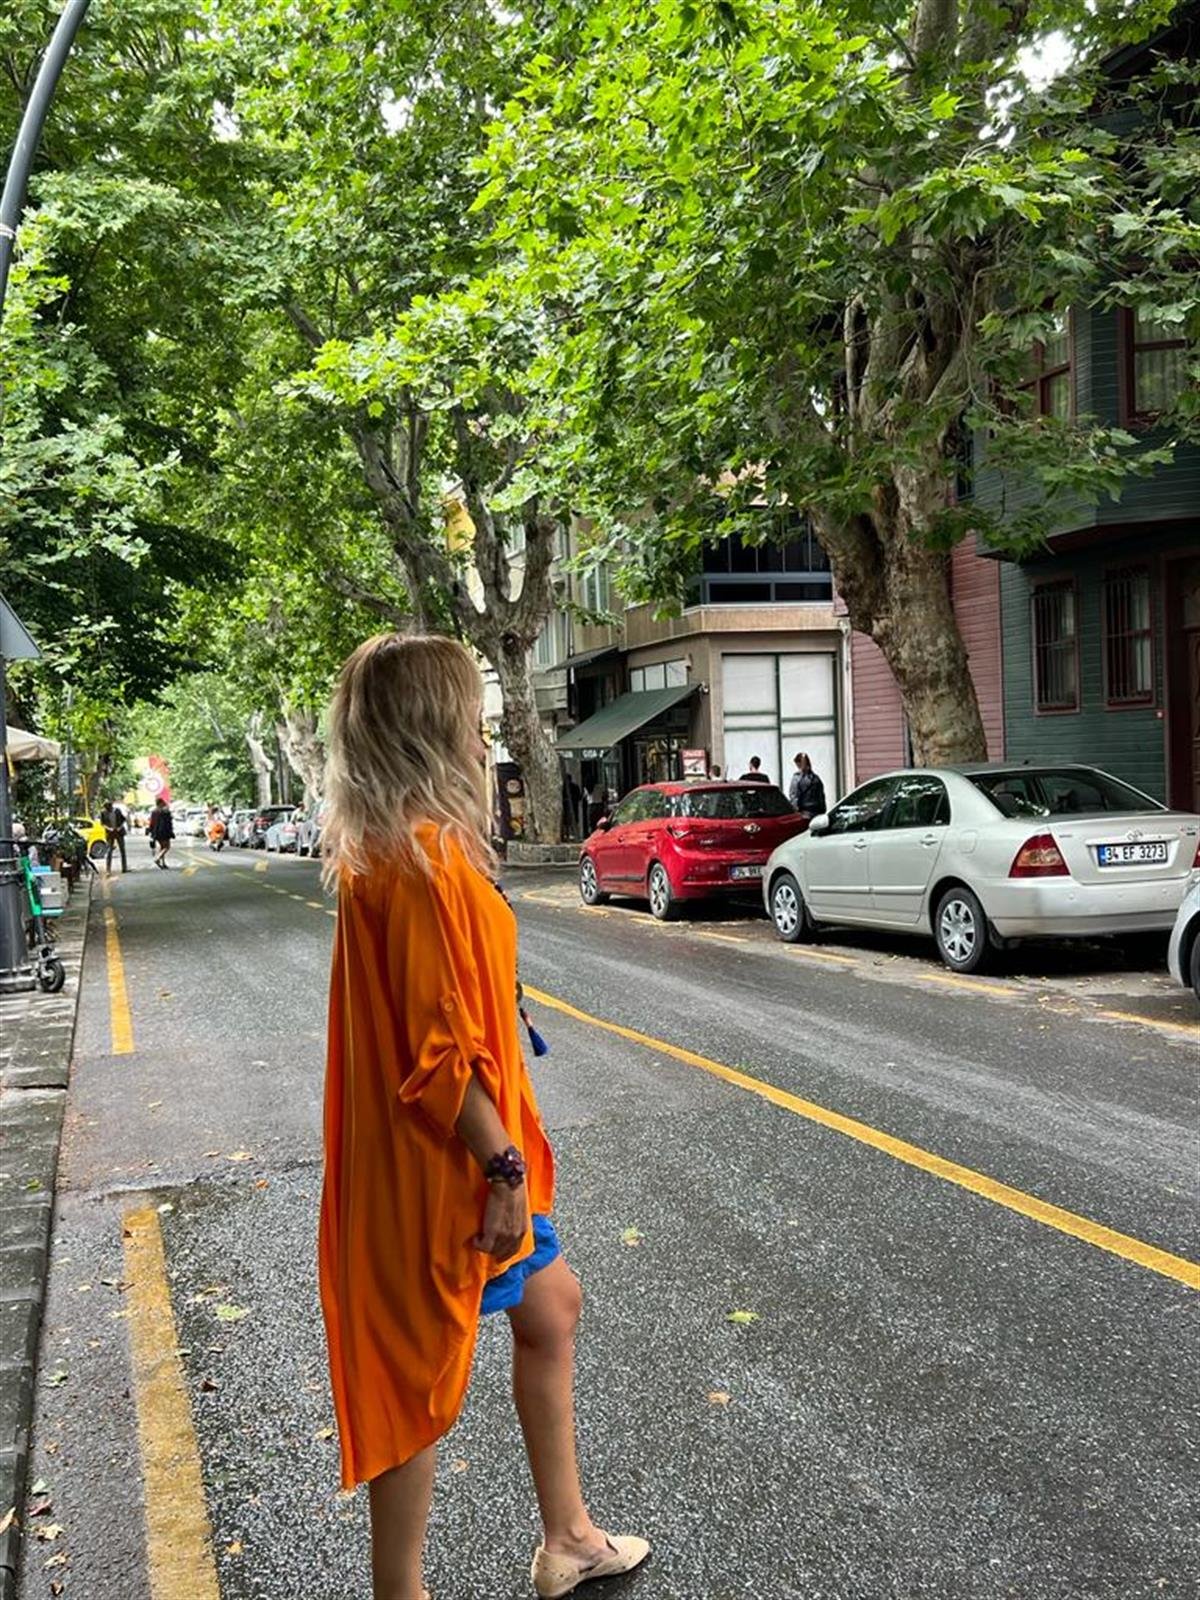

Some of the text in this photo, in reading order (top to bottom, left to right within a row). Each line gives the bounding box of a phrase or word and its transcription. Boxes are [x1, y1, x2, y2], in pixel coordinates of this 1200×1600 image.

[1105, 844, 1164, 860] 34 EF 3273
